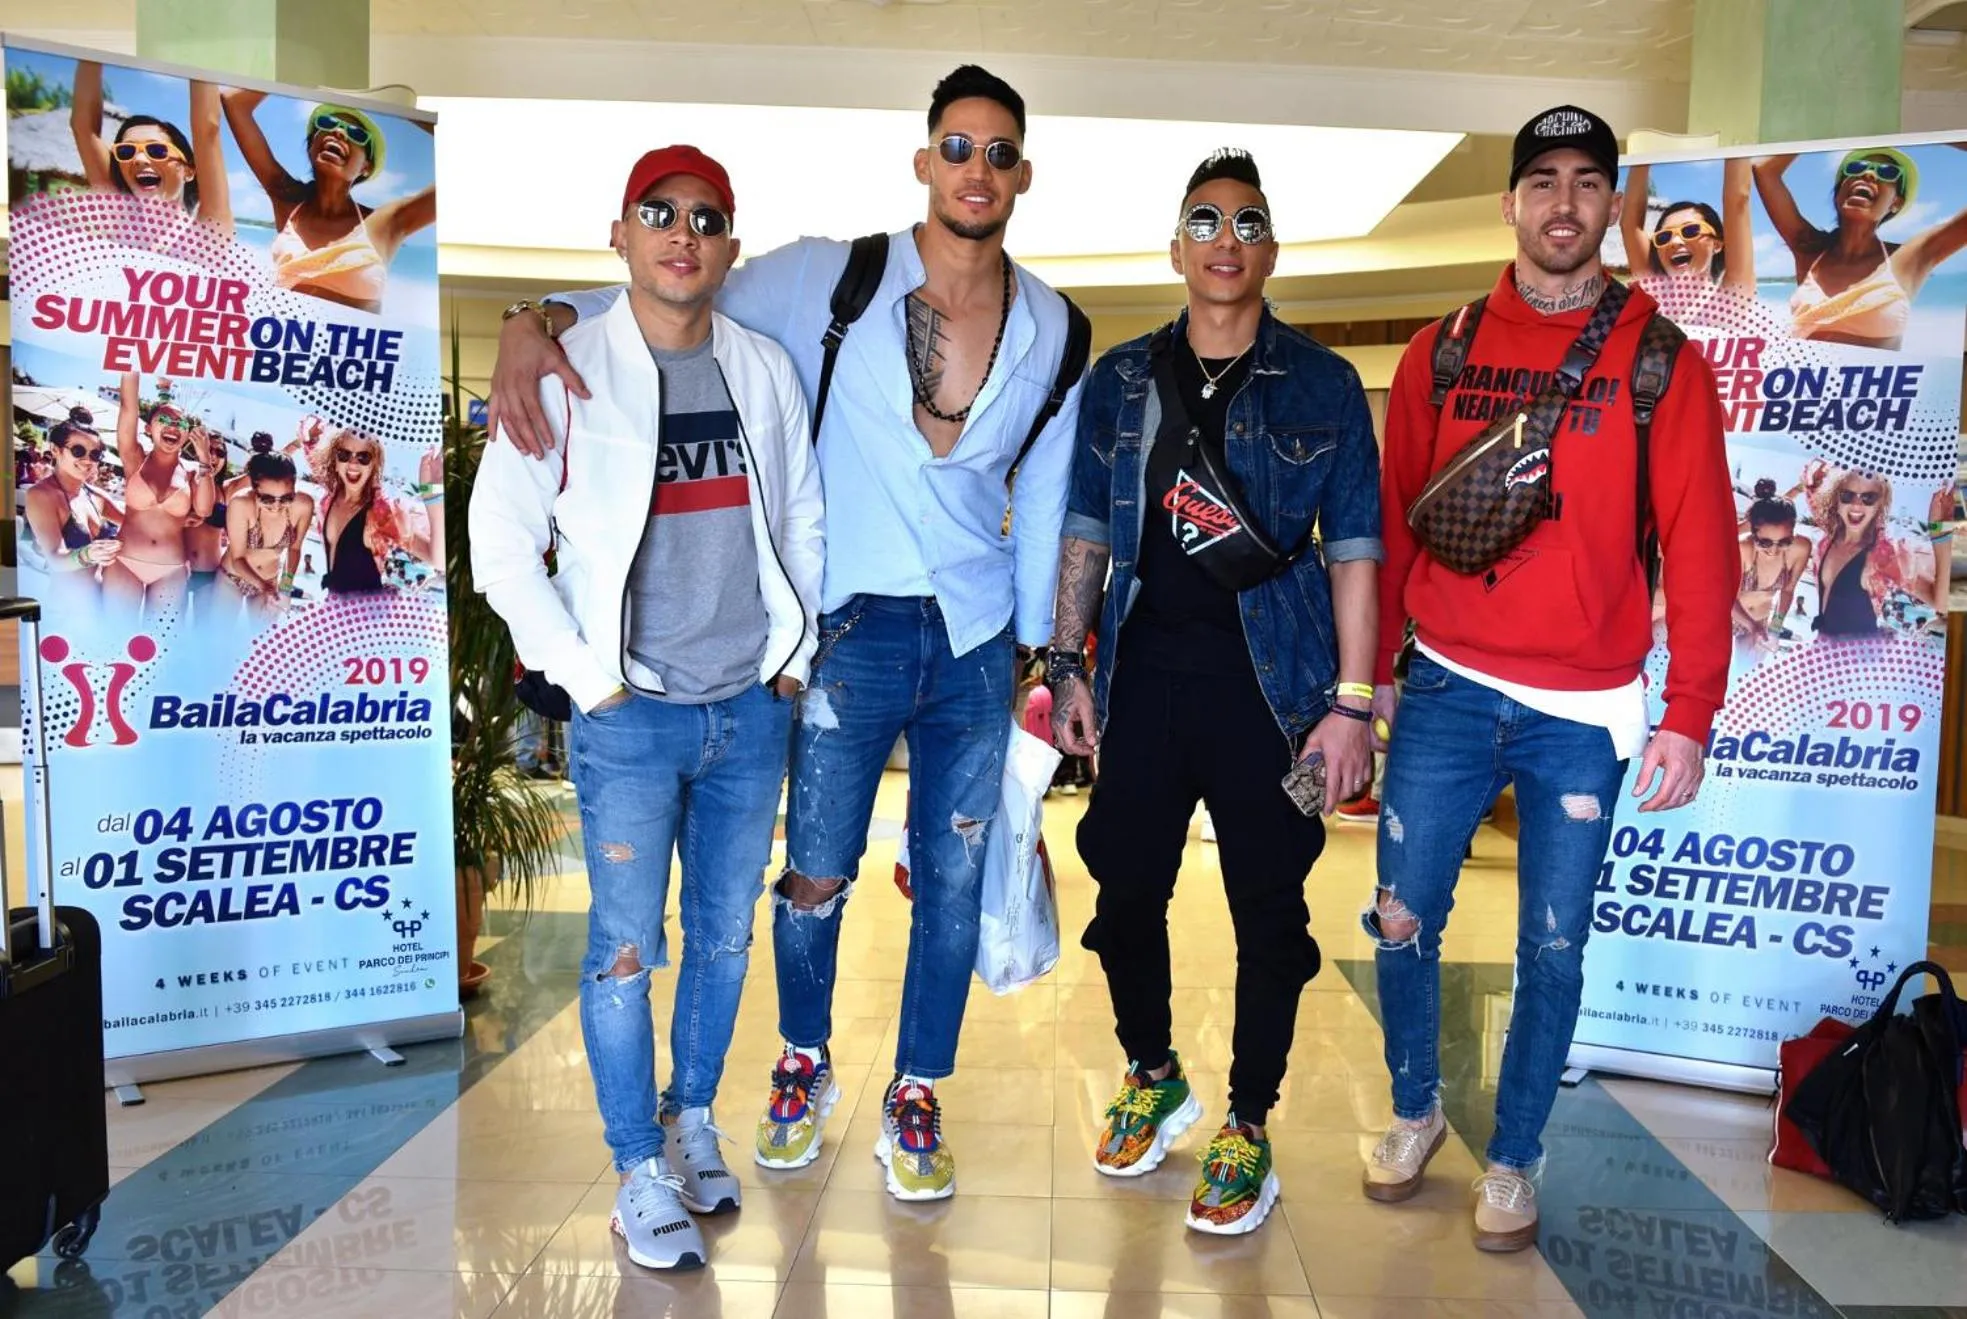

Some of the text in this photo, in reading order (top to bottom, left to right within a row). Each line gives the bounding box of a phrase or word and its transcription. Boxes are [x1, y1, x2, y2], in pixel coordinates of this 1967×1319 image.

[122, 268, 250, 314] YOUR
[32, 295, 403, 361] SUMMER ON THE
[103, 337, 394, 393] EVENT BEACH
[1688, 338, 1766, 369] UR
[1763, 366, 1829, 400] ON
[1839, 365, 1923, 399] THE
[1759, 399, 1912, 432] BEACH
[343, 656, 430, 685] 2019
[149, 691, 431, 729] BailaCalabria
[1826, 700, 1923, 732] 2019
[240, 726, 432, 745] la vacanza spettacolo
[1702, 729, 1921, 774] laCalabria
[1716, 763, 1918, 791] la vacanza spettacolo
[97, 797, 383, 846] dal 04 AGOSTO
[60, 832, 416, 890] al 01 SETTEMBRE
[1613, 826, 1855, 878] 04 AGOSTO
[119, 882, 300, 931] SCALEA
[335, 875, 390, 911] CS
[1625, 864, 1890, 920] SETTEMBRE
[1592, 901, 1757, 949] SCALEA
[1793, 922, 1855, 959] CS
[359, 951, 450, 970] PARCO DEI PRINCIPI
[393, 942, 423, 953] HOTEL
[155, 957, 349, 989] 4 WEEKS OF EVENT
[225, 1001, 250, 1015] +39
[255, 998, 277, 1011] 345
[344, 987, 366, 1000] 344
[1616, 980, 1802, 1013] 4 WEEKS OF EVENT
[1820, 1004, 1851, 1017] PARCO
[1853, 1009, 1868, 1020] DEI
[1851, 995, 1880, 1007] HOTEL
[1674, 1020, 1698, 1032] +39
[1702, 1022, 1724, 1034] 345
[1727, 1026, 1778, 1041] 2272818
[698, 1169, 730, 1180] PUMA
[653, 1220, 691, 1237] PUMA
